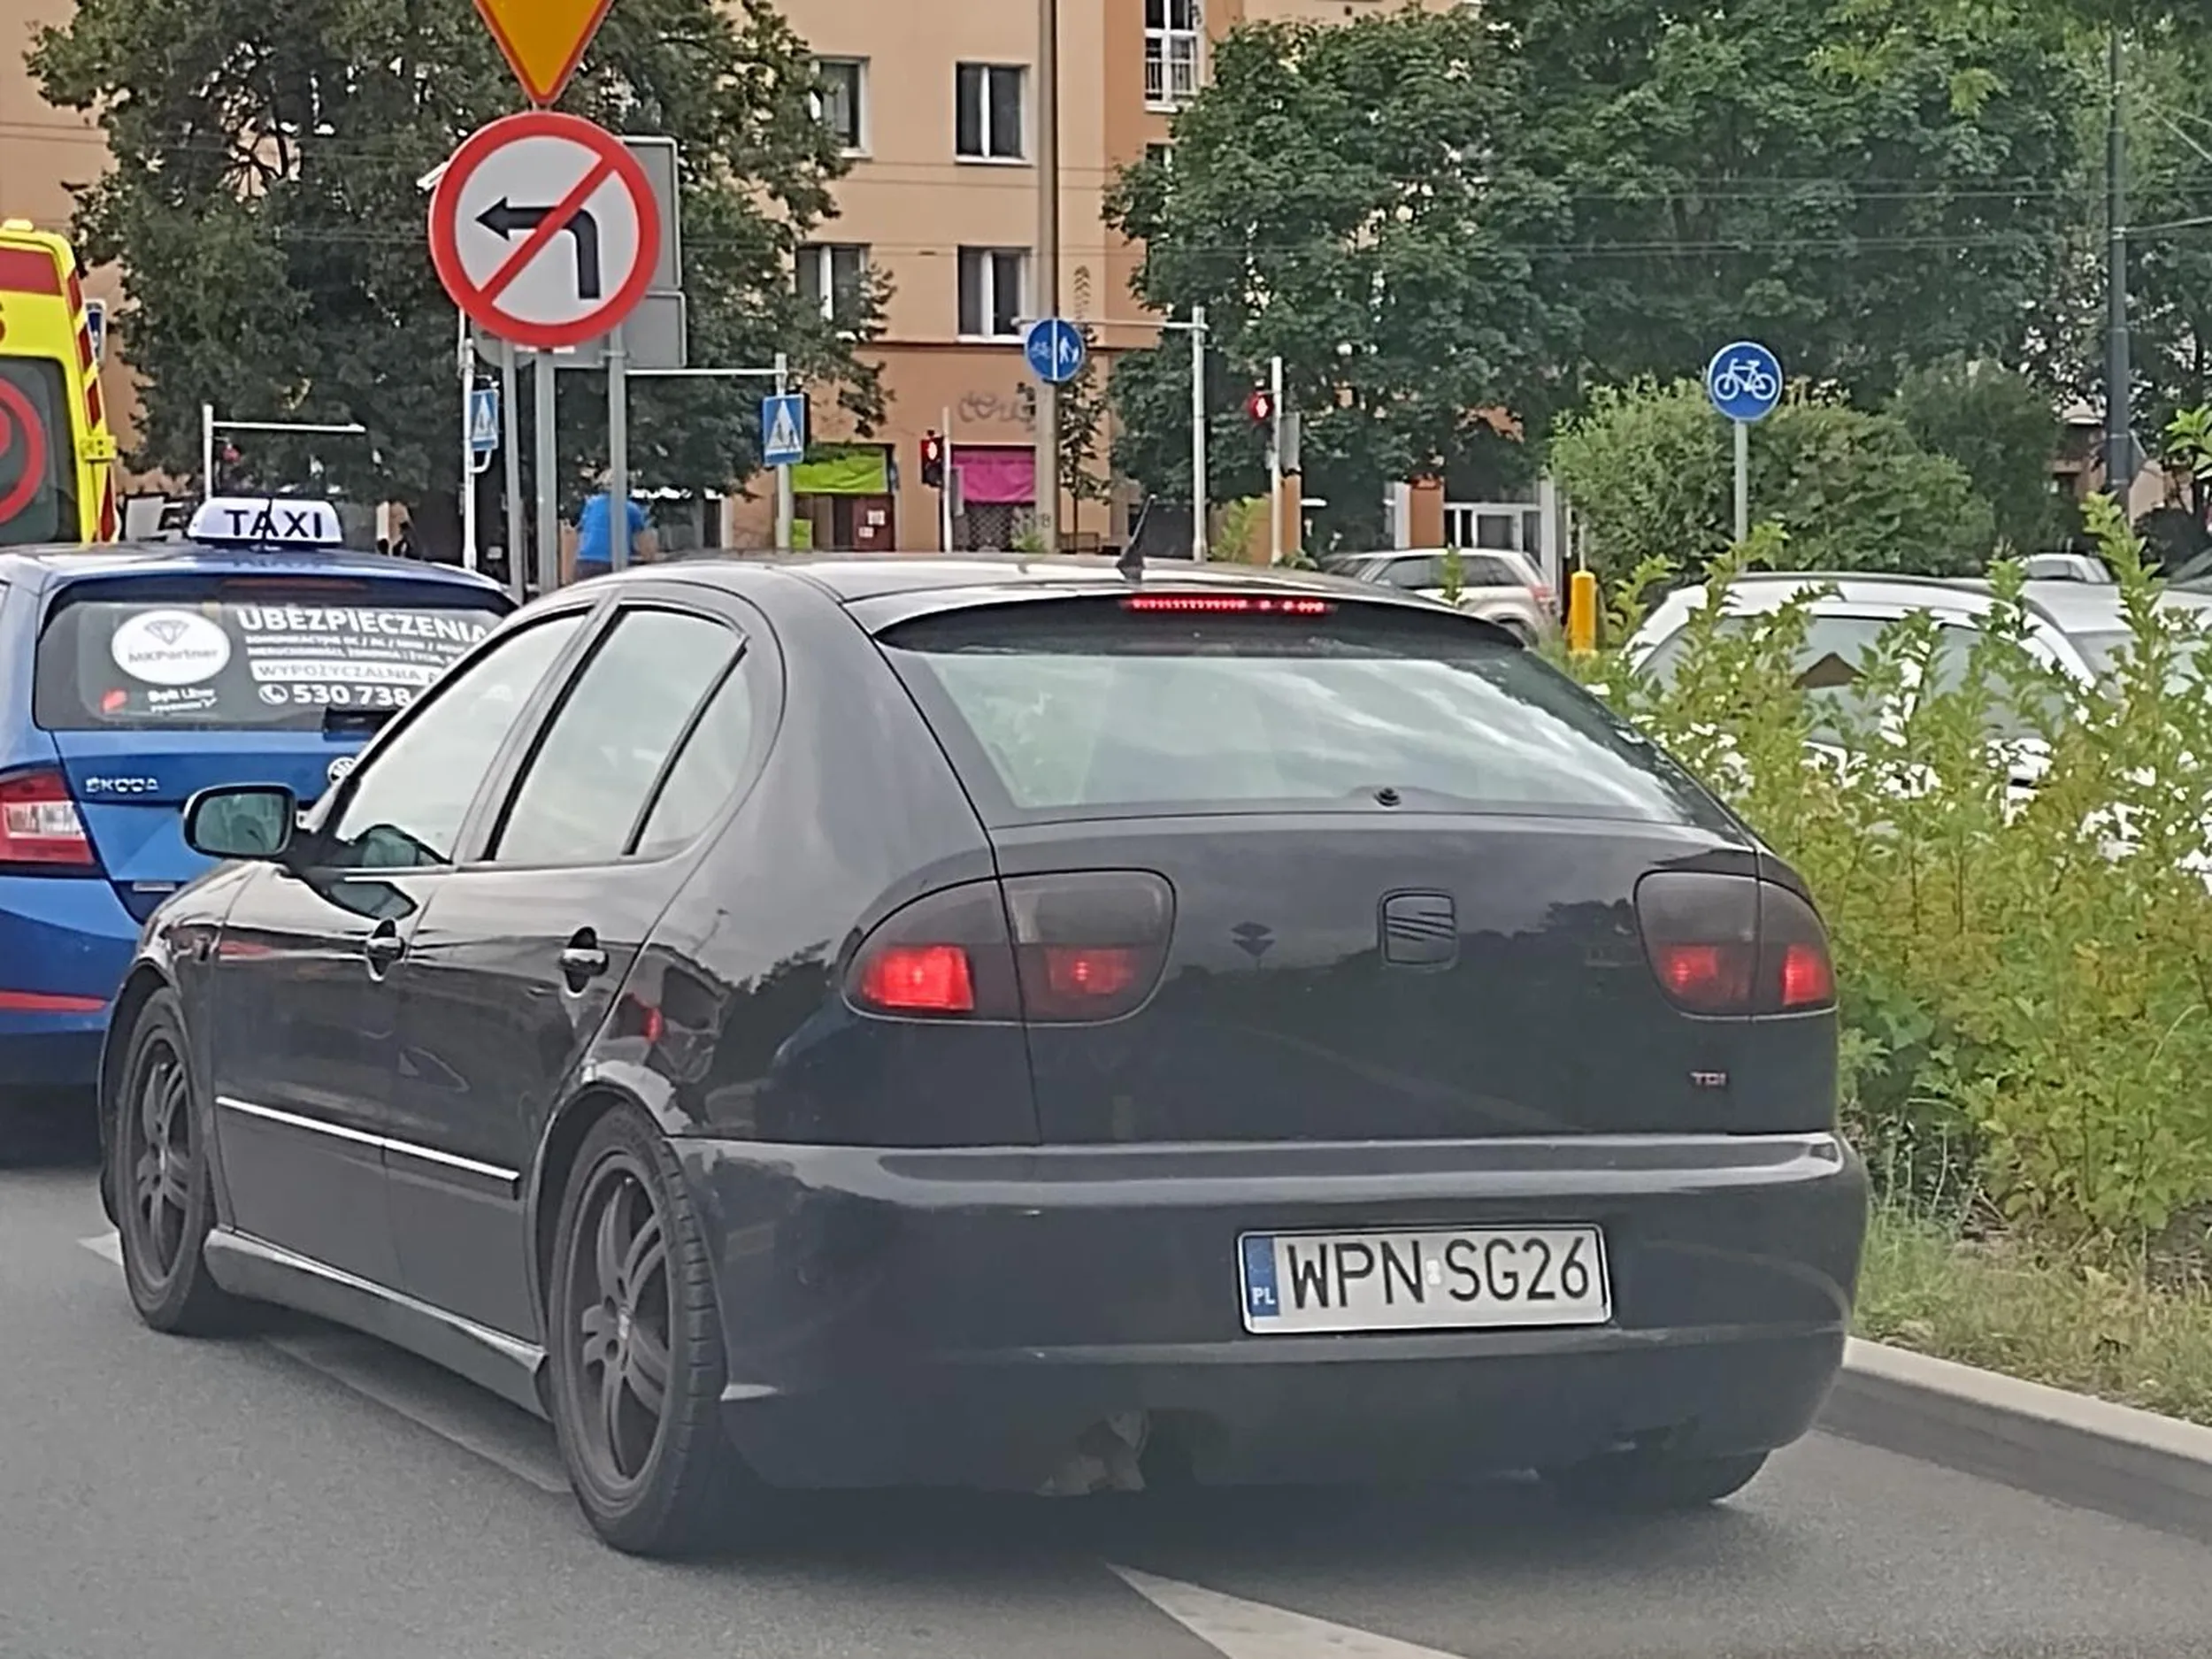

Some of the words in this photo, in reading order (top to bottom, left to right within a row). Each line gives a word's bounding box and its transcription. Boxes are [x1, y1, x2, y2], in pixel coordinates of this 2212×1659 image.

[224, 510, 322, 539] TAXI
[292, 684, 350, 705] 530
[354, 686, 411, 708] 738
[1689, 1071, 1726, 1087] TDI
[1287, 1240, 1425, 1310] WPN
[1445, 1237, 1590, 1302] SG26
[1252, 1286, 1276, 1306] PL
